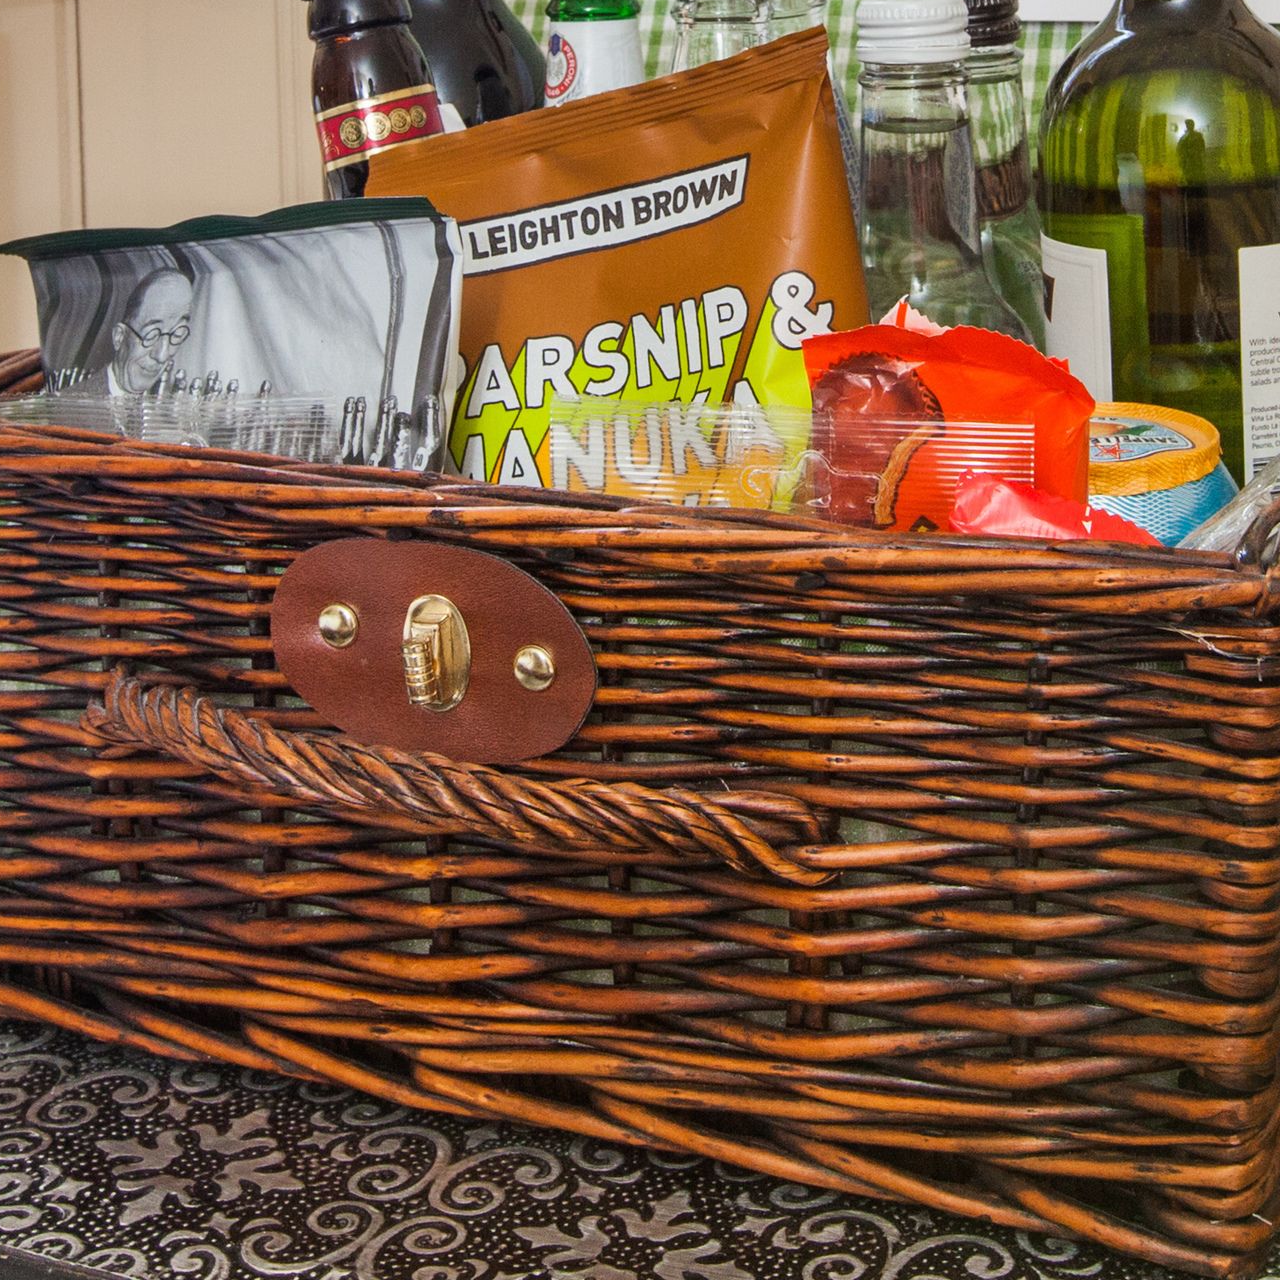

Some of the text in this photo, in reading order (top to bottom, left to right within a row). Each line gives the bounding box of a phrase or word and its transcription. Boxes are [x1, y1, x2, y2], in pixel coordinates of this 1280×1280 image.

[469, 169, 738, 260] LEIGHTON BROWN
[770, 270, 833, 350] &
[1249, 337, 1267, 347] With
[1250, 355, 1275, 367] Central
[1250, 367, 1271, 378] subtle
[1250, 377, 1271, 387] salads
[1250, 404, 1278, 413] Produced
[1251, 424, 1270, 432] Fundo
